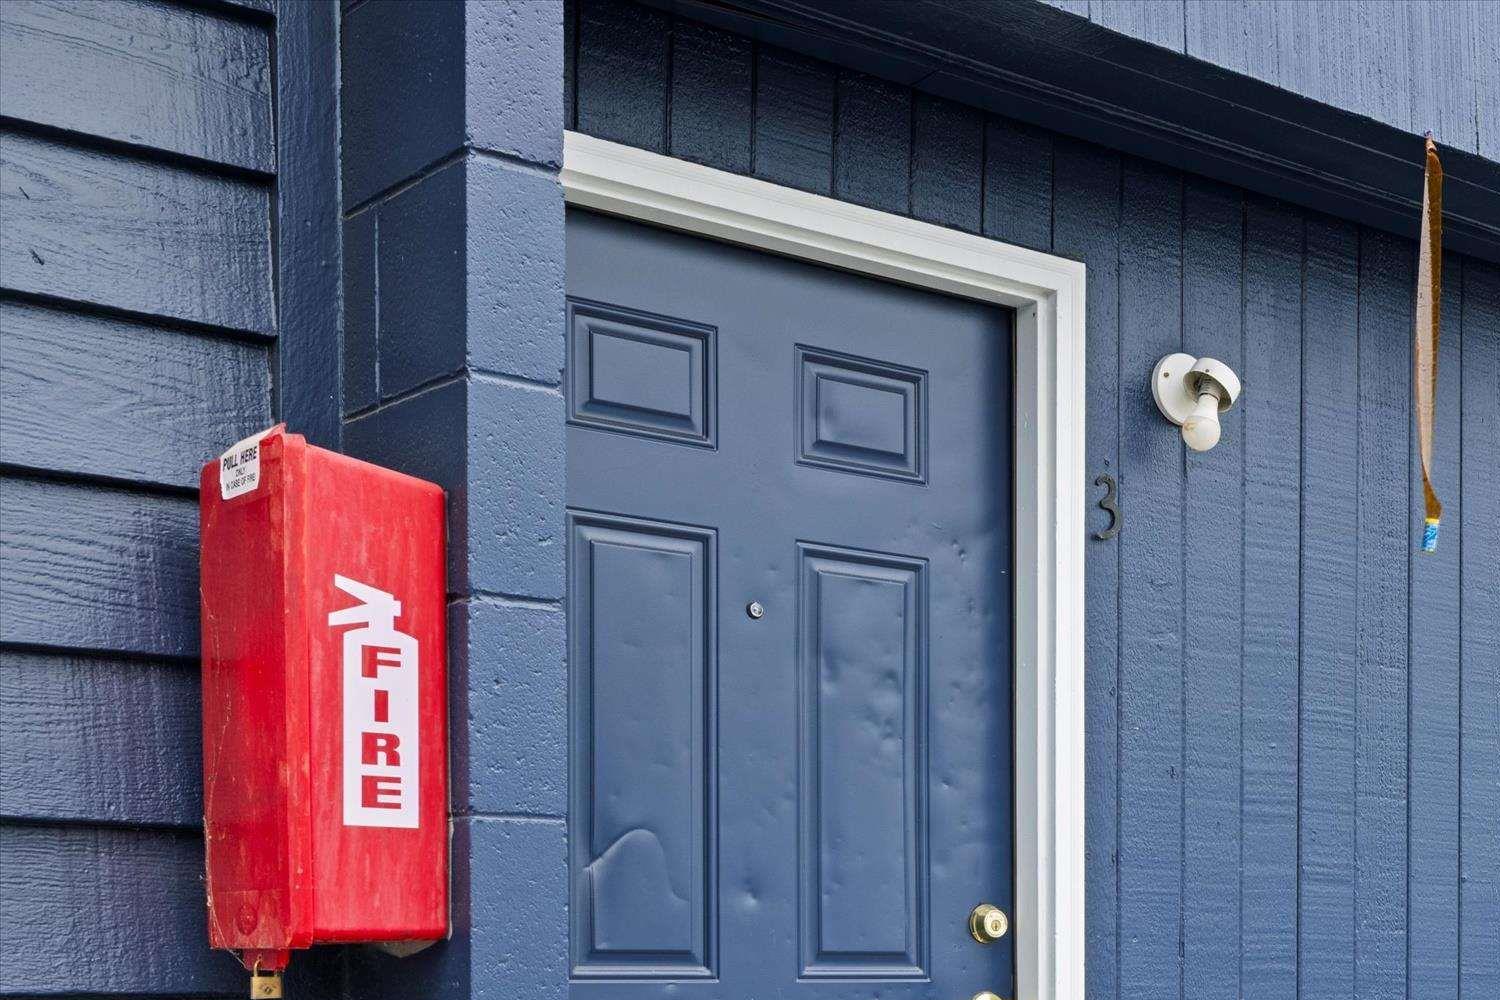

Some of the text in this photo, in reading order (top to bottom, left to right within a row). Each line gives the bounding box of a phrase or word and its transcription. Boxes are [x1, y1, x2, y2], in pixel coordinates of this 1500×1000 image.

[223, 446, 257, 472] PULL HERE
[1094, 473, 1123, 541] 3
[361, 644, 402, 811] FIRE
